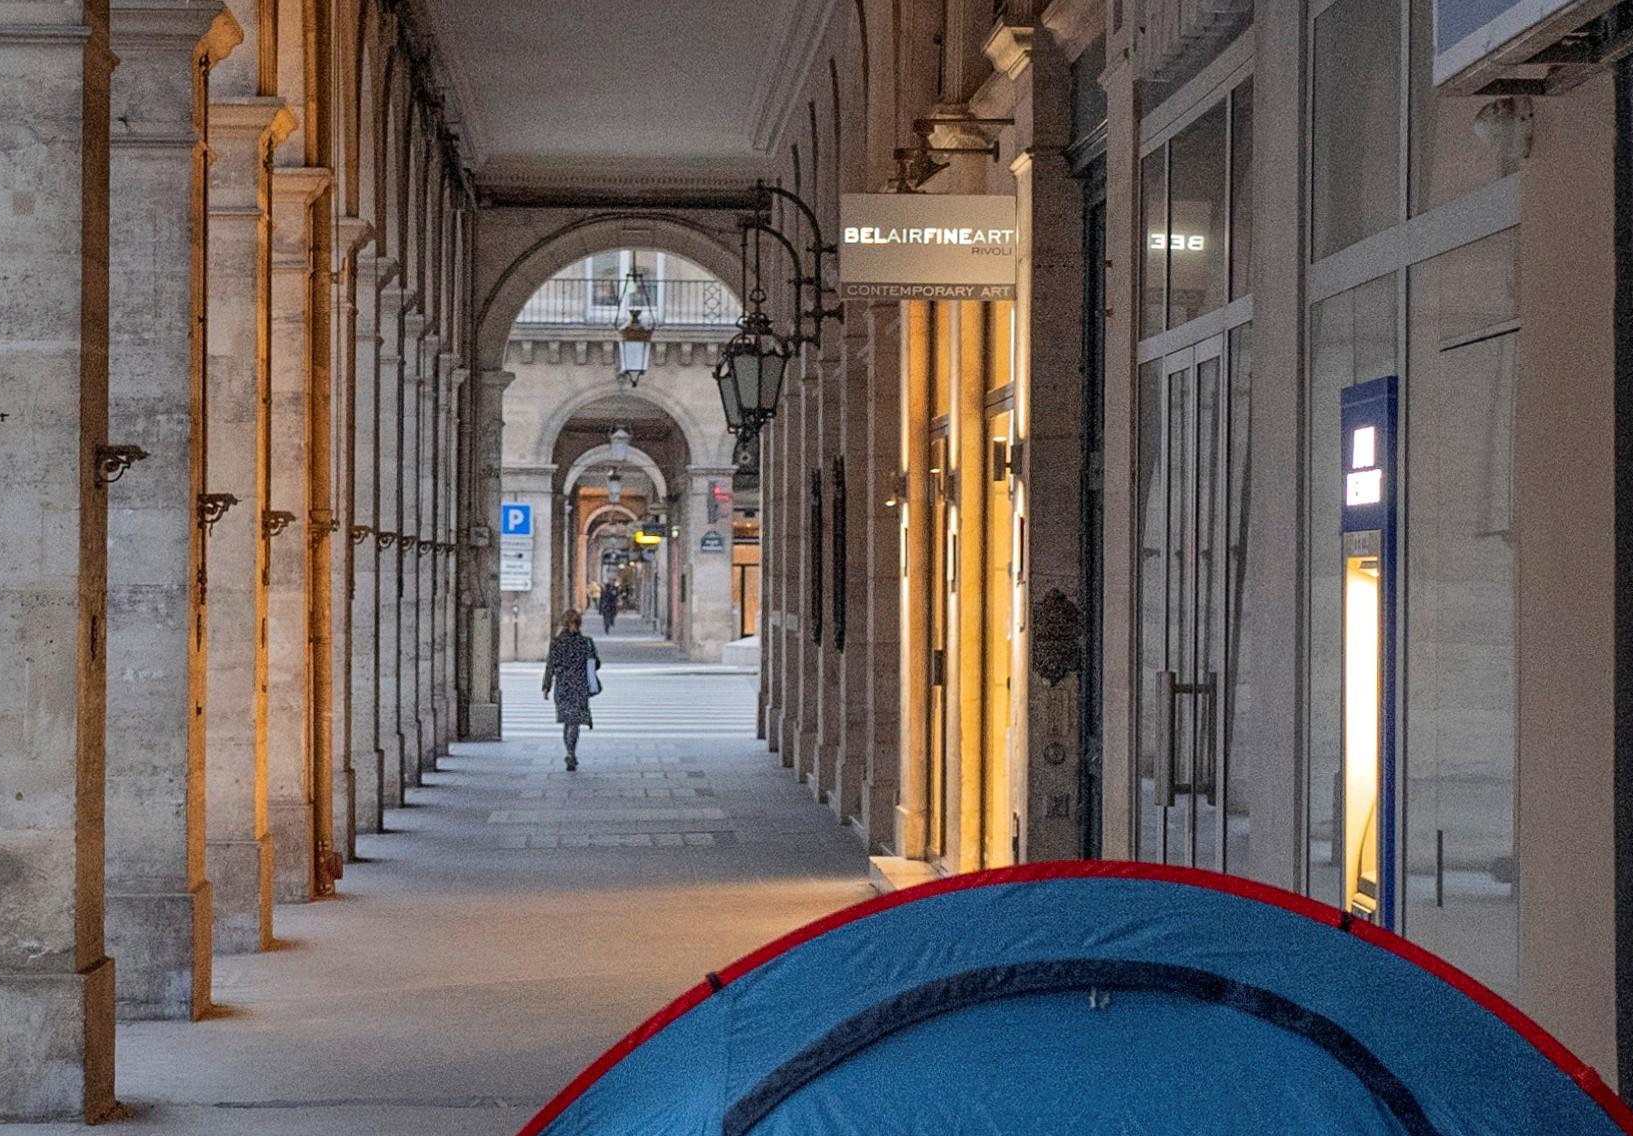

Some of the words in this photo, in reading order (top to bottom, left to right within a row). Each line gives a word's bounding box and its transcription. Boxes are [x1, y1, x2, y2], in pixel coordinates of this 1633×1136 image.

[971, 246, 1013, 257] RIVOLI
[846, 284, 976, 298] CONTEMPORARY
[980, 285, 1011, 298] ART
[508, 508, 525, 532] P
